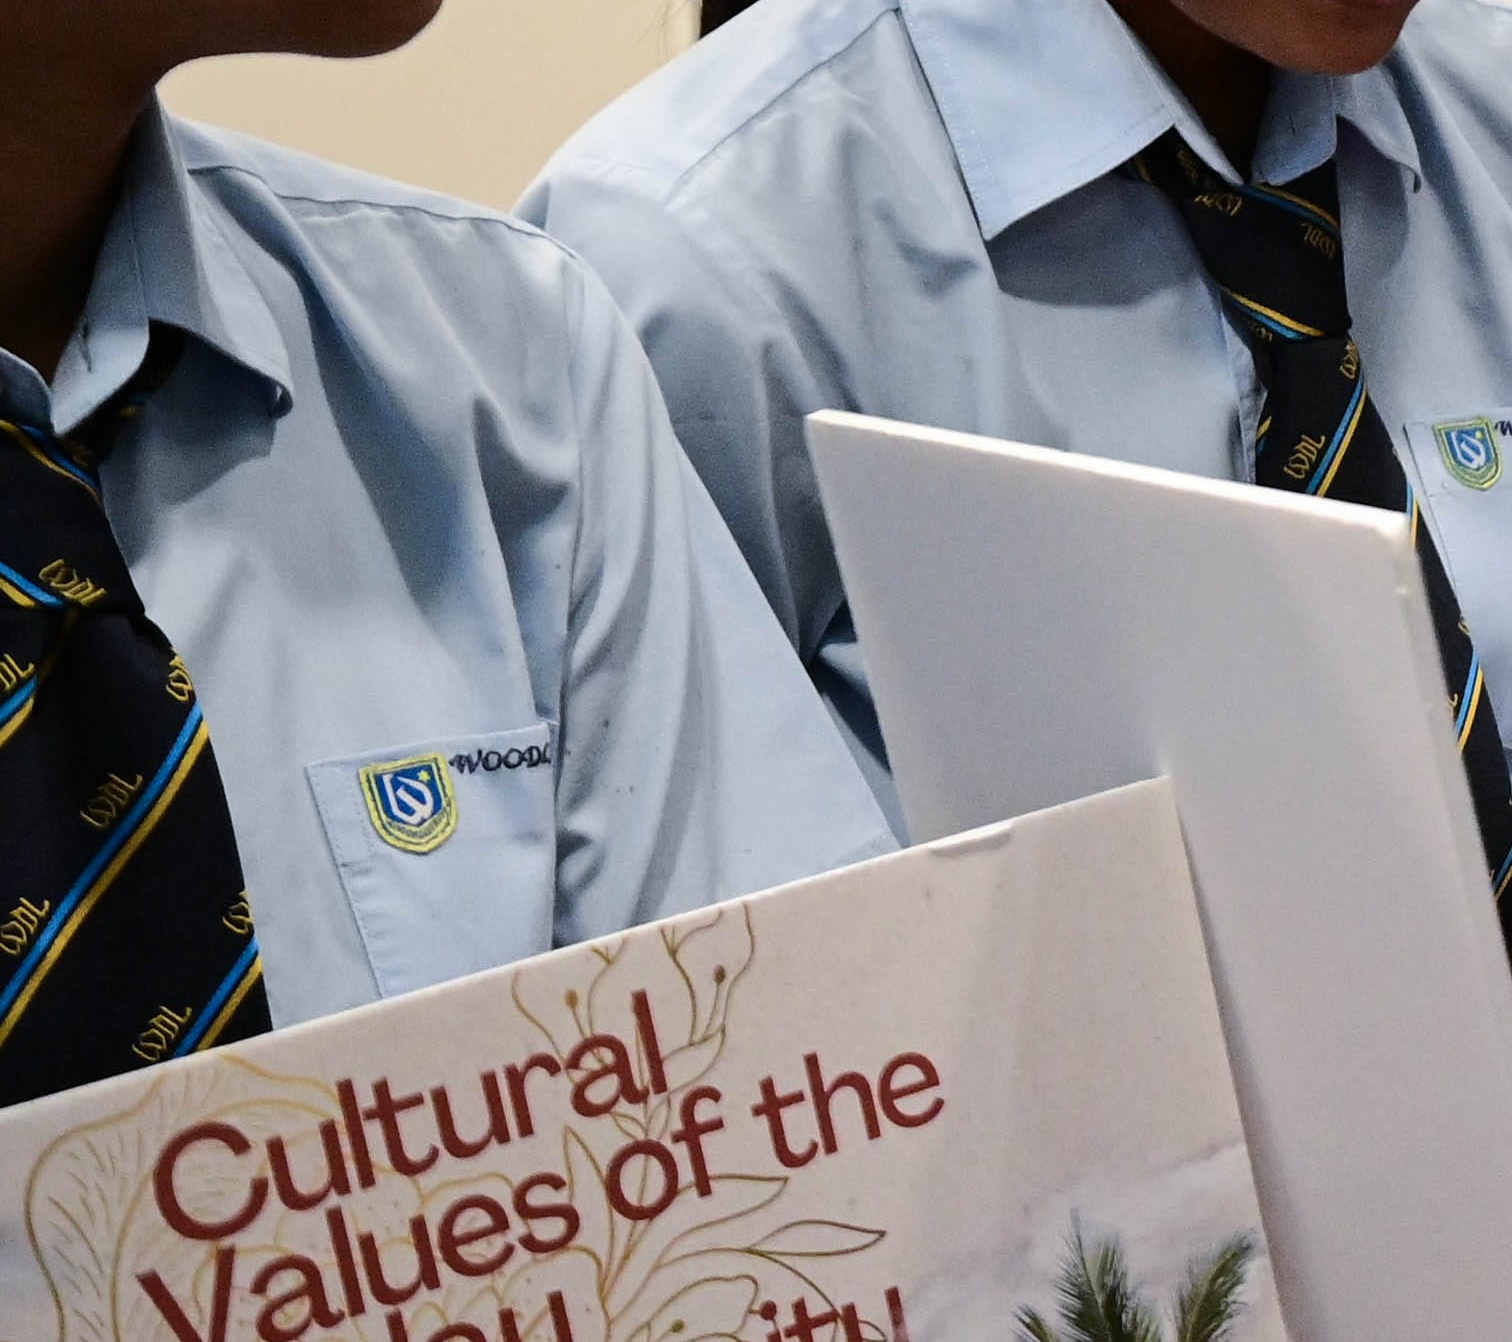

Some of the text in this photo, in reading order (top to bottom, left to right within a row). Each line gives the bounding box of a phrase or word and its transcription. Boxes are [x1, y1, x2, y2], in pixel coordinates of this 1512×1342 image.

[152, 989, 668, 1241] Cultural
[605, 1085, 724, 1222] of
[751, 1050, 946, 1169] the
